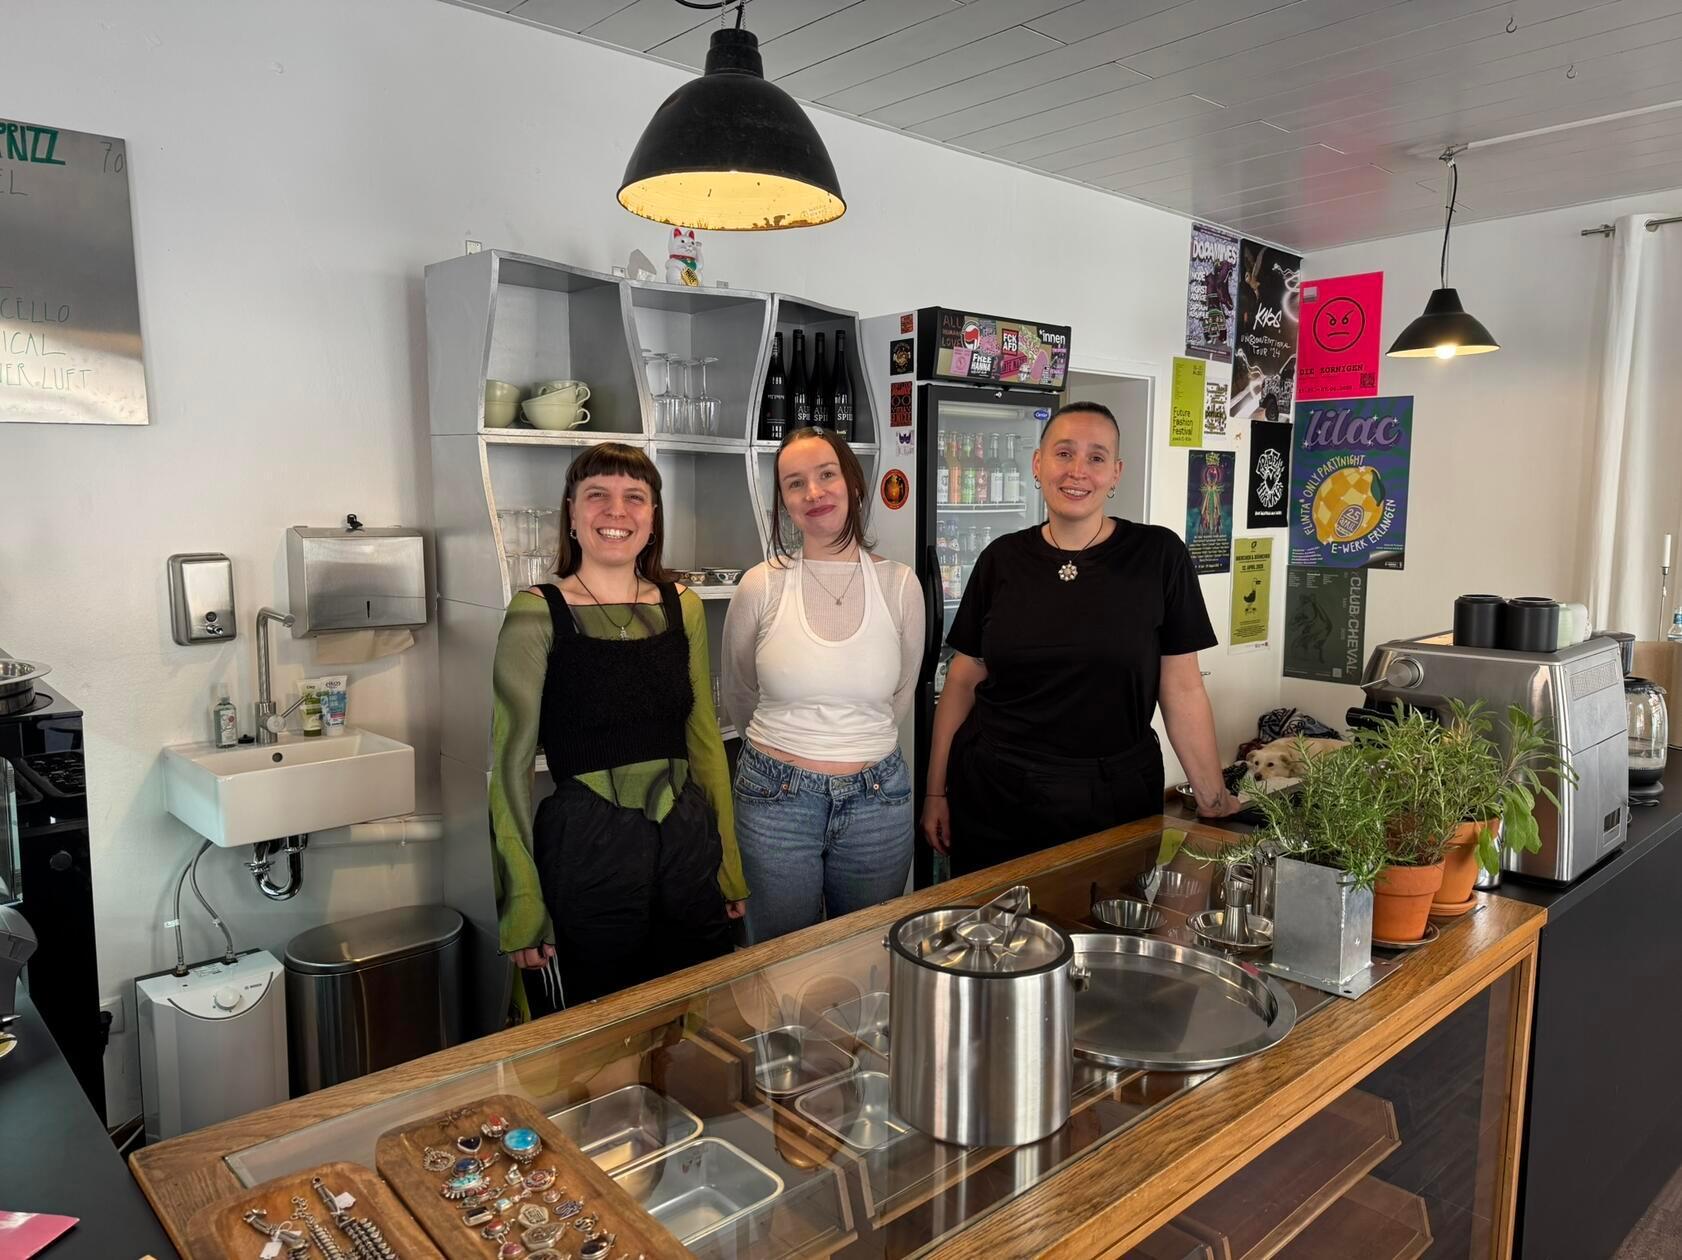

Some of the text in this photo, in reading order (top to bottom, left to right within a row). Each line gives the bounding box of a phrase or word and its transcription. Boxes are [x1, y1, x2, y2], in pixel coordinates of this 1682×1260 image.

[1003, 332, 1018, 342] FCK
[1002, 342, 1018, 352] AFD
[1299, 364, 1364, 376] DIE ZORNIGEN
[42, 366, 94, 391] LUFT
[1173, 407, 1191, 417] Future
[1173, 416, 1194, 427] Fashion
[1172, 425, 1193, 436] Festival
[1304, 409, 1401, 447] lilac
[1303, 474, 1322, 498] ONLY
[1317, 454, 1367, 477] PARTYNIGHT
[1331, 499, 1397, 554] E-WERK ERLANGEN
[1346, 576, 1362, 675] CLUB CHEVAL
